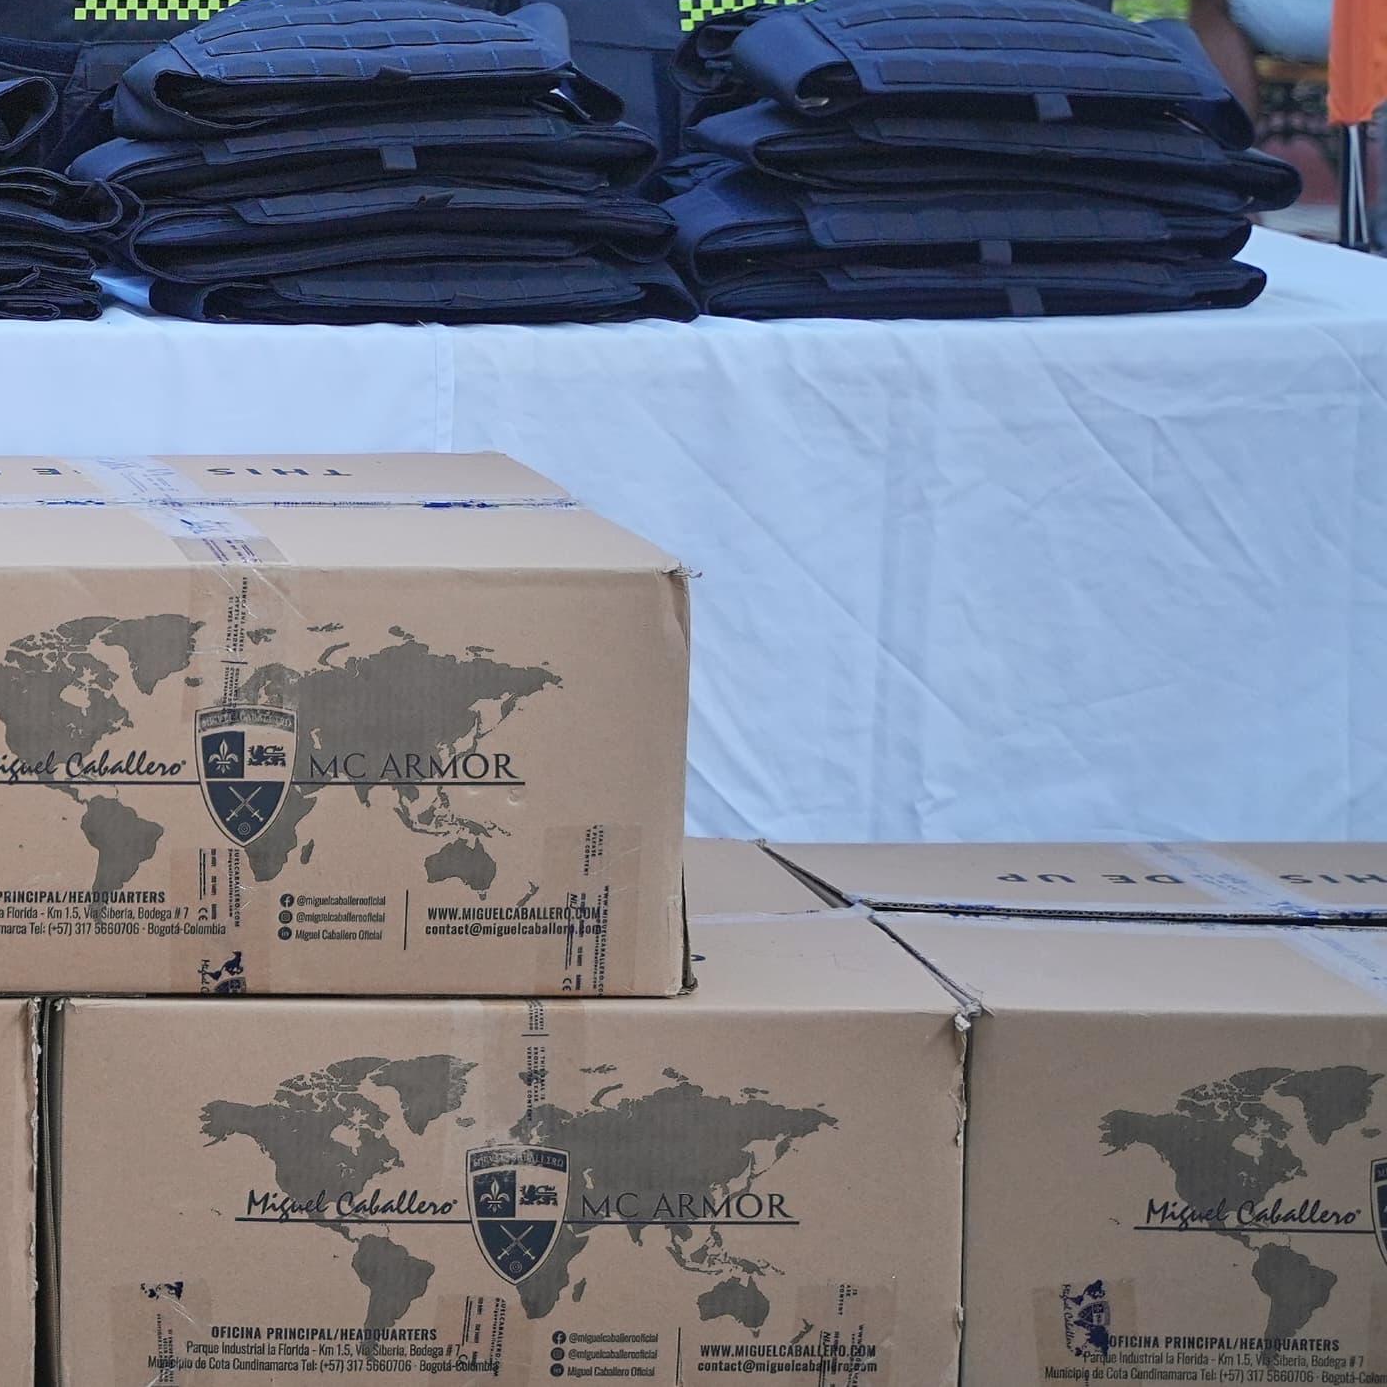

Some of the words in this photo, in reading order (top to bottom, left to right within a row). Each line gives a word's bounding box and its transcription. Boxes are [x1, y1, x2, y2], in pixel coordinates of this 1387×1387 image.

[65, 747, 184, 778] Caballero
[308, 752, 367, 779] MC
[379, 751, 521, 782] ARMOR
[996, 872, 1077, 884] UP
[246, 1188, 327, 1224] Miguel
[335, 1187, 455, 1217] Caballero
[581, 1192, 640, 1219] MC
[652, 1191, 794, 1221] ARMOR
[1145, 1197, 1228, 1232] Miguel
[1237, 1197, 1359, 1226] Caballero
[211, 1325, 262, 1340] OFICINA
[266, 1325, 438, 1344] PRINCIPAL/HEADQUARTERS
[1108, 1334, 1160, 1348] OFICINA
[1164, 1335, 1340, 1352] PRINCIPAL/HEADQUARTERS
